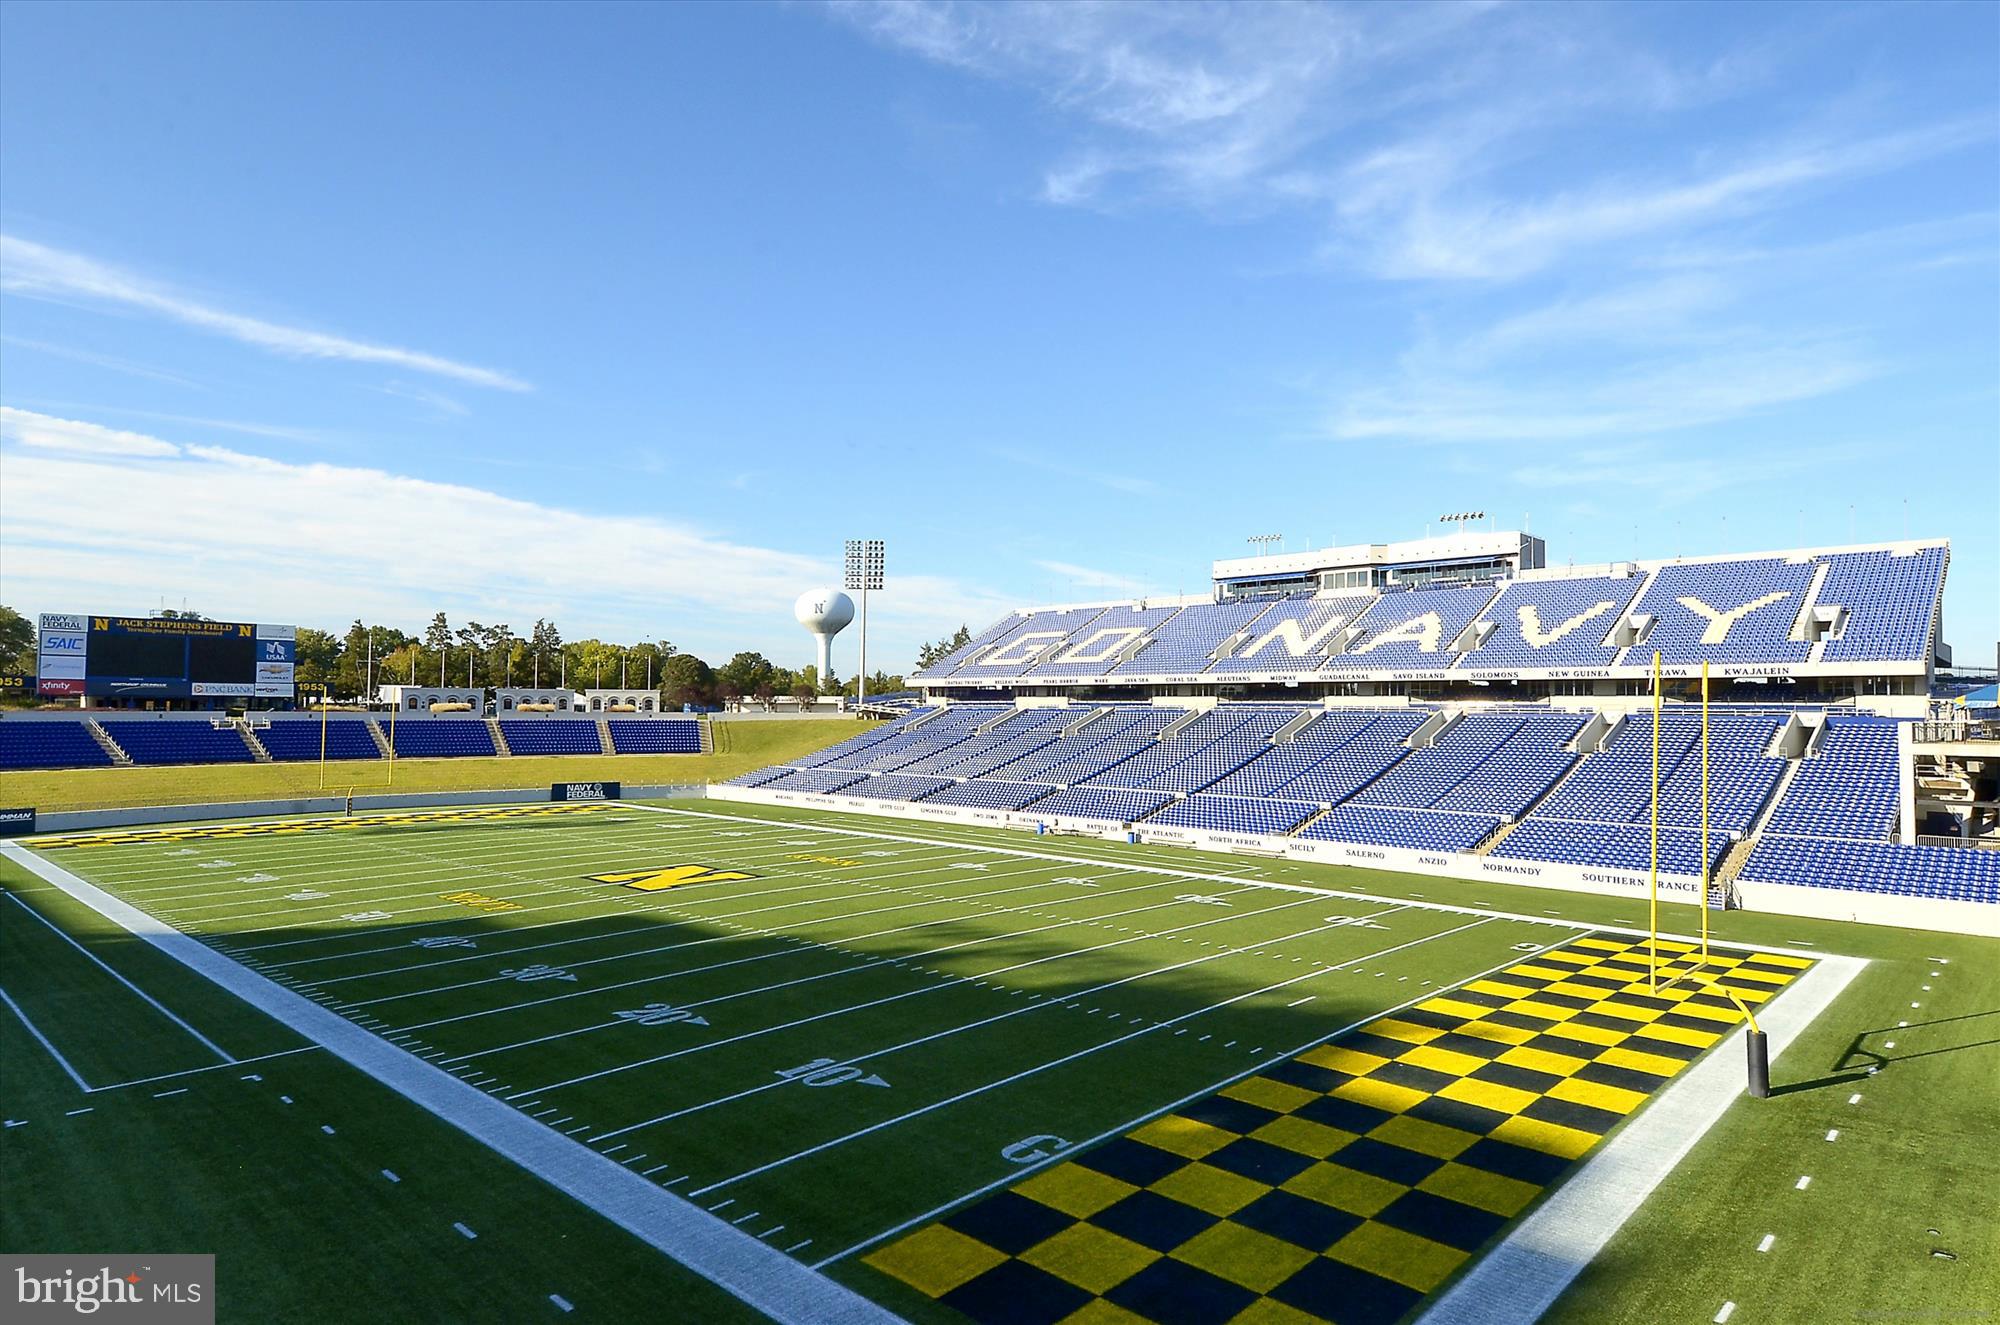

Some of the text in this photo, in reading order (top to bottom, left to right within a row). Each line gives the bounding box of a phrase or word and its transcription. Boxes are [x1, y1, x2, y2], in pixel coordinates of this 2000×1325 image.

[815, 603, 823, 614] N
[42, 621, 82, 629] FEDERAL
[95, 618, 109, 631] N
[116, 619, 233, 631] JACK STEPHENS FIELD
[980, 592, 1791, 665] GO NAVY
[239, 625, 252, 637] N
[44, 637, 84, 650] SAIC
[1724, 667, 1790, 676] KWAJALEIN
[42, 682, 70, 690] xfinity
[298, 683, 325, 691] 1953
[567, 783, 592, 791] NAVY
[567, 790, 605, 798] FEDERAL
[1087, 823, 1108, 831] BATTLE
[1152, 830, 1185, 838] ATLANTIC
[1208, 835, 1261, 847] NORTH AFRICA
[1289, 843, 1316, 853] SICILY
[1345, 849, 1385, 860] SALERNO
[1417, 856, 1447, 866] ANZIO
[1482, 863, 1542, 877] NORMANDY
[1582, 873, 1699, 893] SOUTHERN RANCE
[612, 1003, 693, 1026] 20
[774, 1057, 863, 1087] 10
[1001, 1134, 1073, 1163] G
